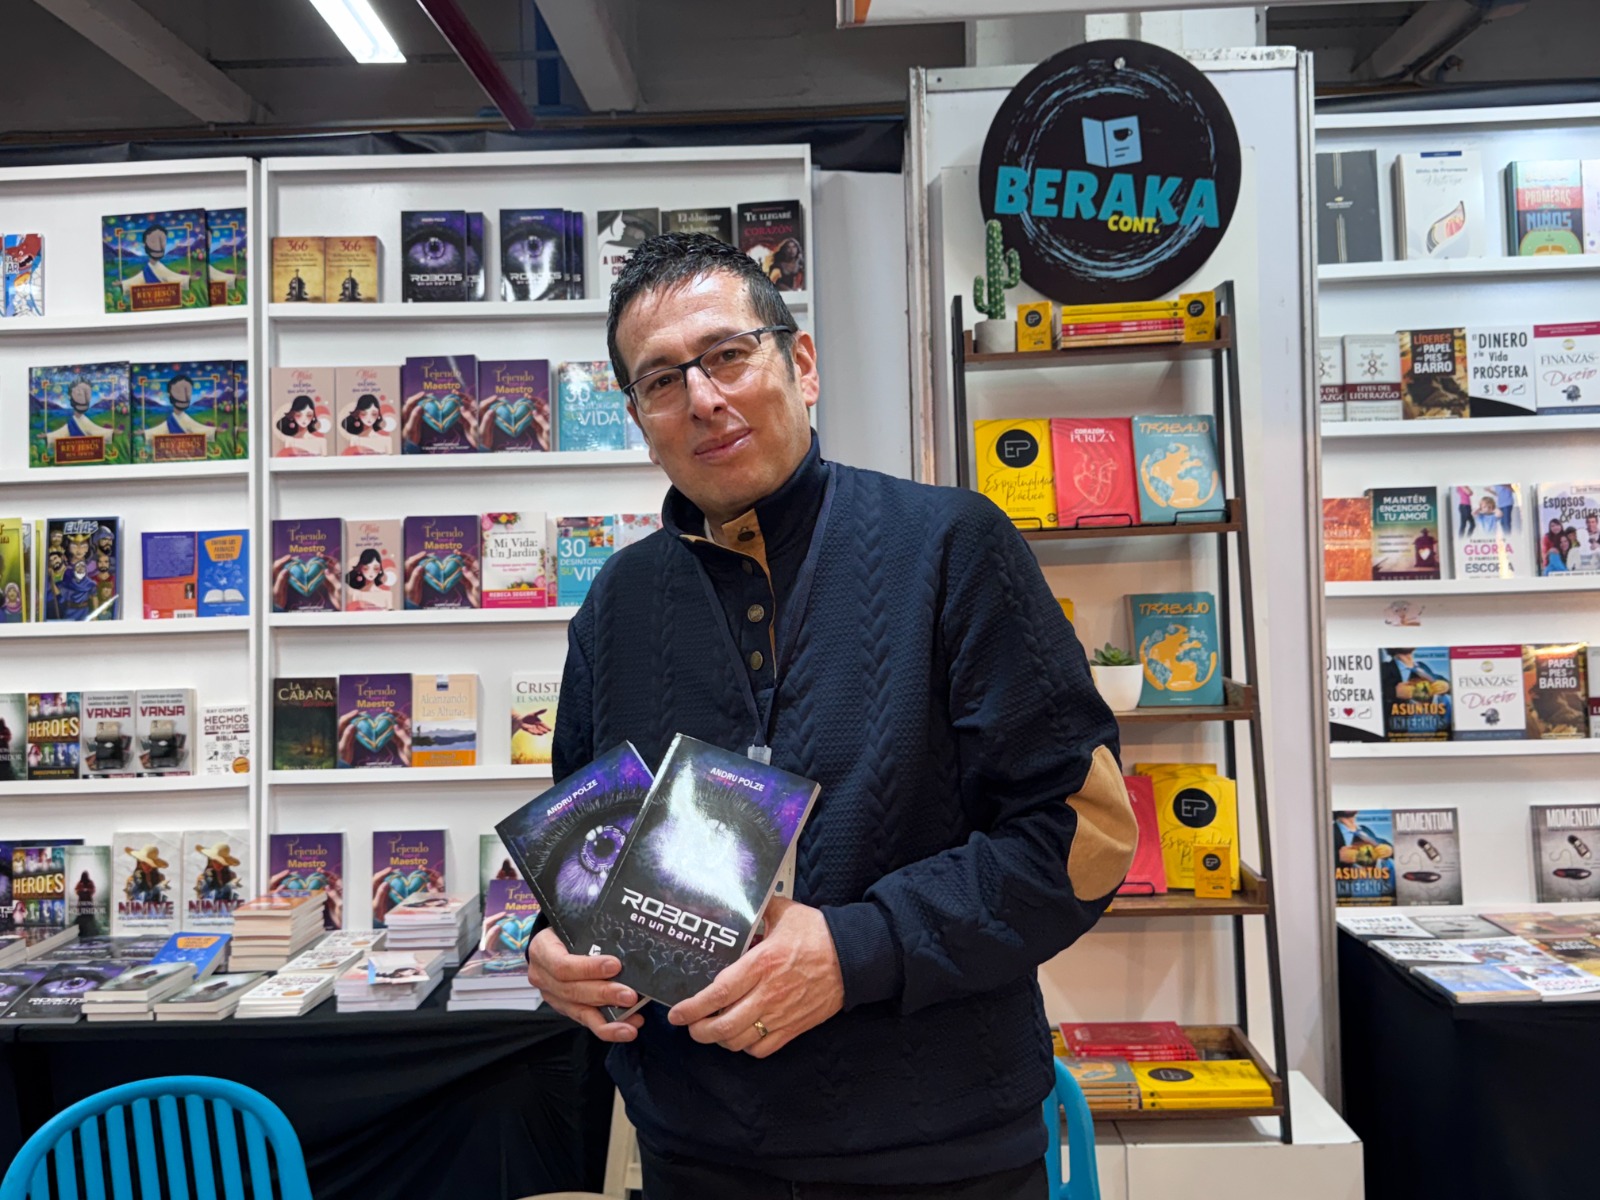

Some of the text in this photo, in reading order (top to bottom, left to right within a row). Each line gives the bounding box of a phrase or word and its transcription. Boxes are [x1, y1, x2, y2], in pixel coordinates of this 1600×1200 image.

[994, 166, 1219, 228] BERAKA
[744, 224, 793, 236] CORAZÓN
[1107, 214, 1160, 234] CONT.
[288, 239, 308, 252] 366
[339, 240, 361, 252] 366
[410, 273, 463, 282] ROBOTS
[1413, 334, 1452, 345] LÍDERES
[1478, 331, 1528, 349] DINERO
[1423, 343, 1451, 353] PAPEL
[1424, 353, 1442, 362] PIES
[1489, 350, 1508, 362] Vida
[1540, 353, 1595, 366] FINANZAS
[1367, 360, 1378, 375] 8
[1413, 361, 1453, 375] BARRO
[423, 381, 461, 391] Maestro
[495, 385, 533, 394] Maestro
[1378, 384, 1391, 392] DEL
[1349, 391, 1400, 401] LIDERAZGO
[579, 410, 621, 426] VIDA
[1139, 421, 1210, 435] TRABAJO
[1382, 494, 1427, 504] MANTÉN
[1543, 496, 1585, 509] Esposos
[1379, 504, 1431, 513] ENCENDIDO
[1383, 512, 1428, 521] TU AMOR
[289, 544, 326, 553] Maestro
[424, 541, 463, 550] Maestro
[494, 537, 538, 548] Mi Vida:
[560, 538, 586, 558] 30
[490, 547, 538, 559] Un Jardín
[1464, 543, 1514, 556] GLORA
[574, 566, 601, 582] VID
[1465, 562, 1515, 574] ESCOA
[1139, 602, 1210, 616] TRABAJO
[1547, 658, 1576, 669] PAPEL
[1549, 668, 1567, 677] PIES
[1334, 674, 1354, 685] Vida
[1458, 676, 1512, 688] FINANZAS
[1539, 676, 1577, 689] BARRO
[290, 682, 300, 690] LA
[516, 681, 560, 694] CRIST
[277, 687, 333, 701] CABAÑA
[516, 694, 559, 703] EL SANAD
[1327, 687, 1375, 702] RÓSPERA
[357, 699, 395, 708] Maestro
[1391, 703, 1446, 716] ASUNTOS
[86, 706, 131, 719] VANYA
[140, 705, 185, 717] VANYA
[204, 714, 249, 725] HECHOS
[28, 717, 80, 737] HEROES
[710, 767, 765, 792] ANDRU POLZE
[546, 779, 598, 817] ANDRU POLZE
[1396, 811, 1453, 831] MOMENTUM
[287, 859, 327, 869] Maestro
[389, 857, 428, 866] Maestro
[1335, 867, 1390, 880] ASUNTOS
[13, 873, 65, 894] HEROES
[507, 886, 535, 901] Tejie
[504, 902, 540, 911] Maestr
[621, 887, 740, 948] ROBOTS
[630, 912, 716, 953] en un barril
